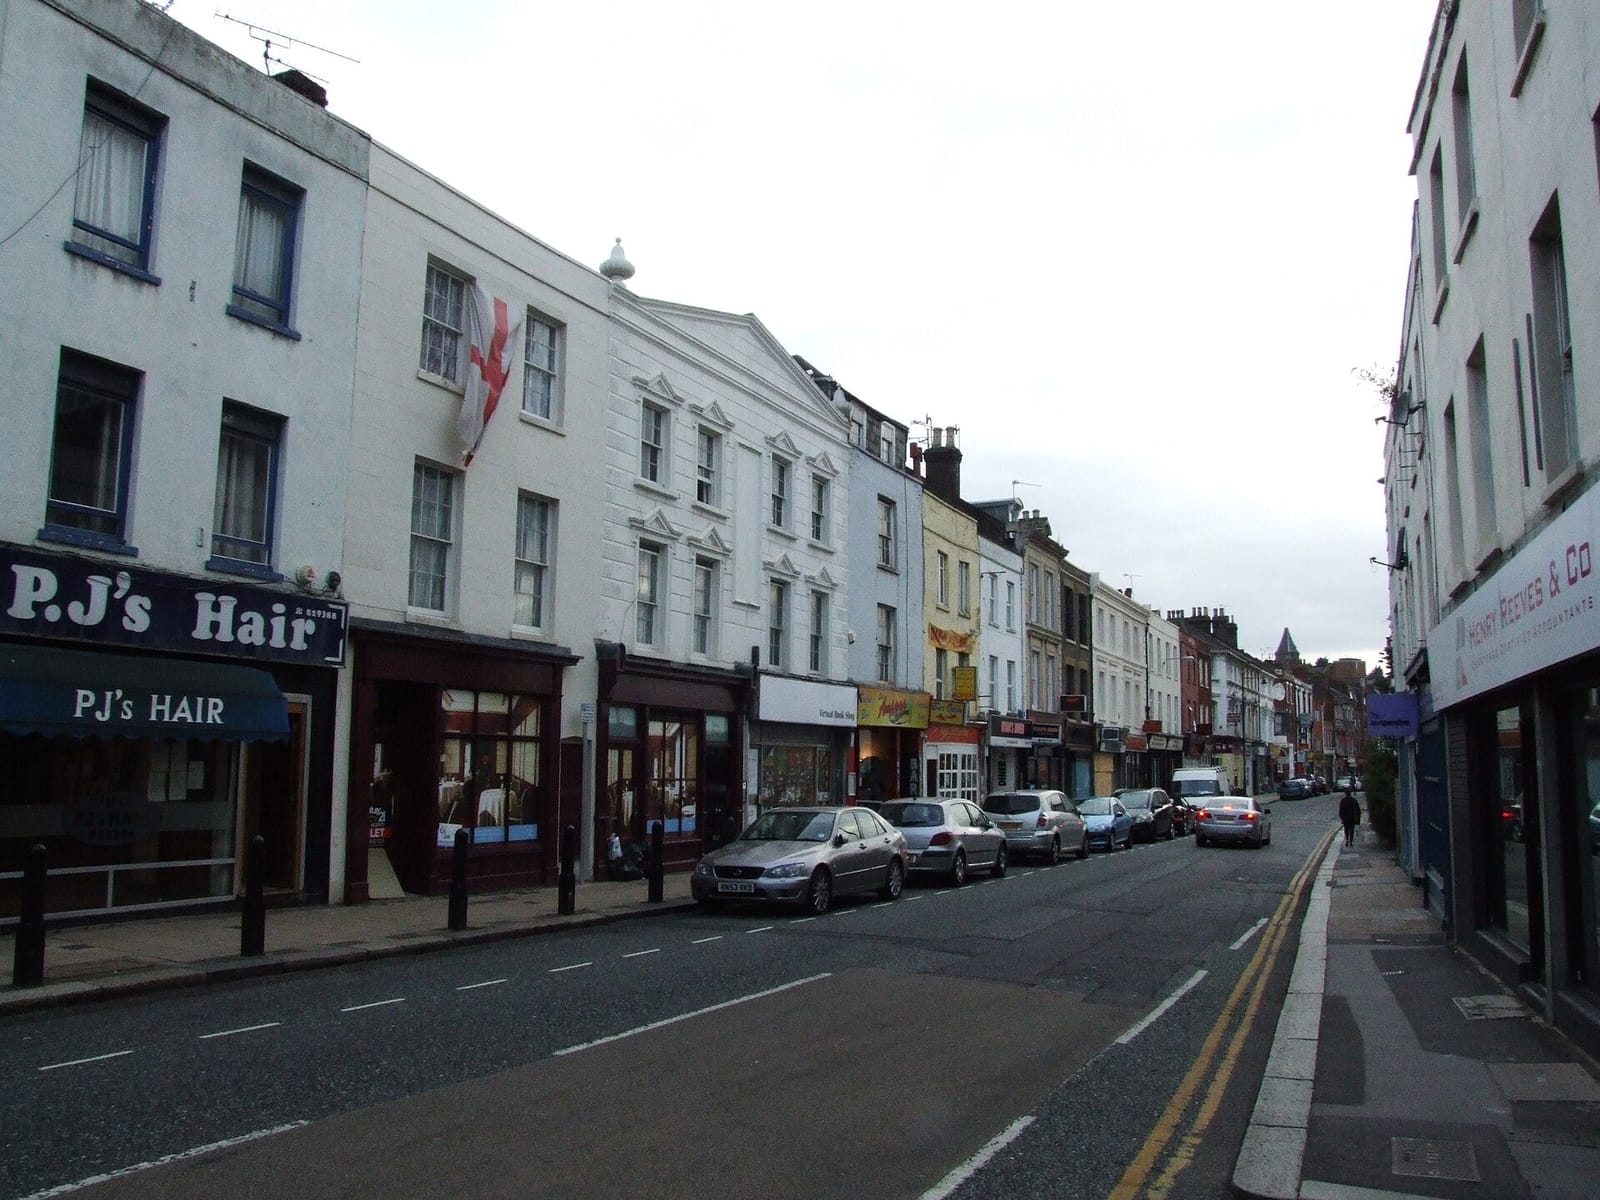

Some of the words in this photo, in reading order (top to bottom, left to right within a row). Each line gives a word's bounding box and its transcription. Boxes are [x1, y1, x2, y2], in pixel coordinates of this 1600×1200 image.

[7, 564, 152, 633] P.J's
[191, 592, 316, 650] Hair
[1500, 577, 1543, 629] REEVES
[1549, 560, 1561, 598] &
[1566, 541, 1591, 586] CO
[149, 694, 224, 725] HAIR
[370, 828, 384, 838] LET
